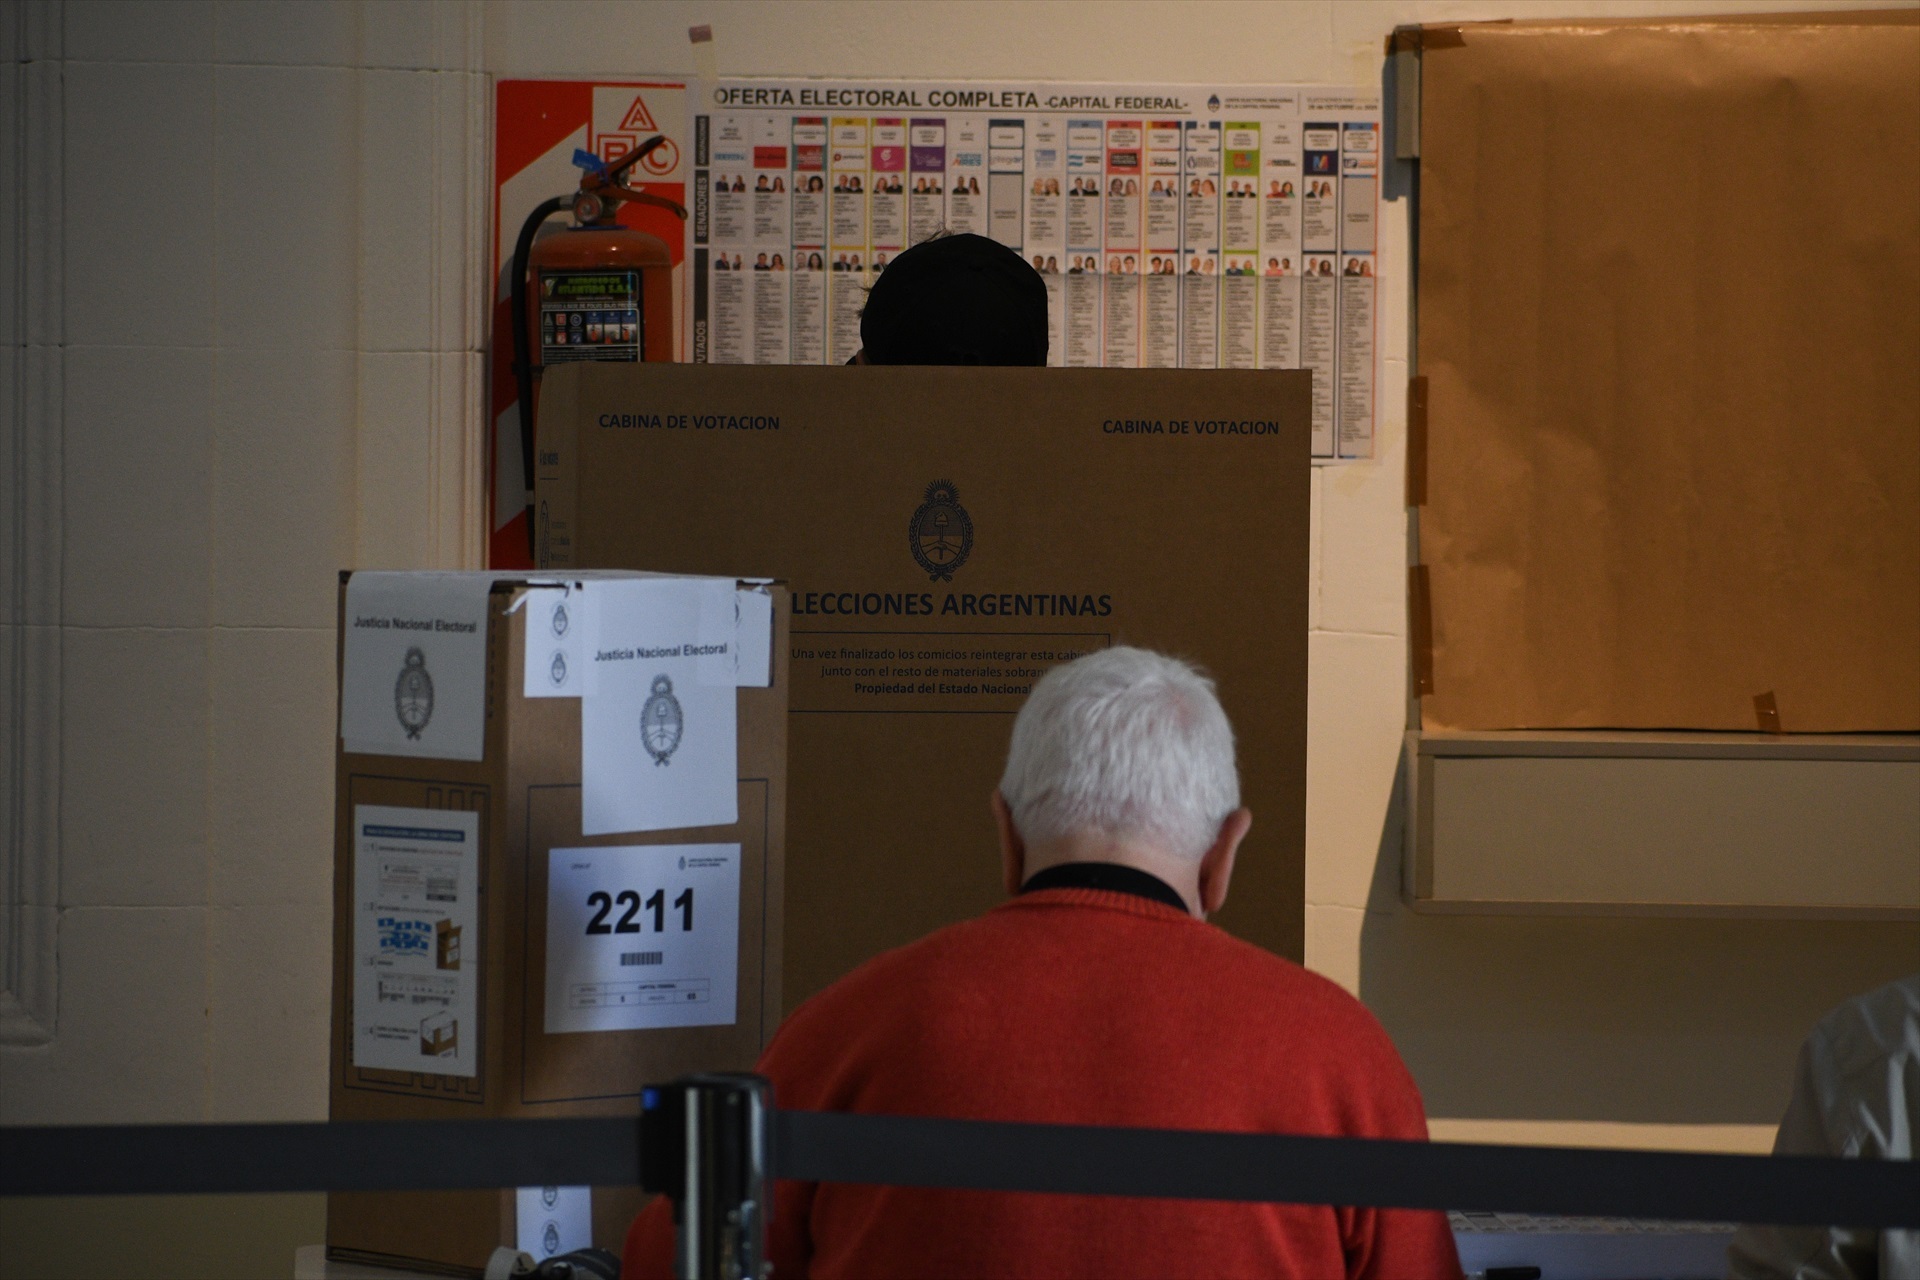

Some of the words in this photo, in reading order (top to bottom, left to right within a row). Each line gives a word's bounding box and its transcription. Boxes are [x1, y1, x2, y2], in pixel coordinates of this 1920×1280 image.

[715, 88, 794, 106] OFERTA
[799, 89, 922, 107] ELECTORAL
[928, 90, 1039, 108] COMPLETA
[630, 108, 647, 126] A
[648, 142, 668, 169] C
[696, 177, 708, 238] SENADORES
[695, 321, 707, 364] UTADOS
[599, 414, 662, 428] CABINA
[667, 415, 688, 429] DE
[692, 415, 780, 430] VOTACION
[1103, 420, 1164, 434] CABINA
[1169, 421, 1189, 435] DE
[1194, 421, 1279, 435] VOTACION
[791, 592, 934, 616] LECCIONES
[941, 593, 1113, 617] ARGENTINAS
[354, 616, 390, 629] Justicia
[392, 617, 433, 631] Nacional
[435, 618, 477, 633] Electoral
[595, 648, 635, 662] Justicia
[637, 645, 681, 659] Nacional
[683, 642, 728, 656] Electoral
[792, 648, 814, 660] Una
[818, 650, 837, 660] vez
[840, 648, 895, 660] finalizado
[898, 648, 915, 660] los
[917, 648, 967, 661] comicios
[970, 649, 1026, 662] reintegrar
[1030, 650, 1054, 661] esta
[820, 666, 852, 679] junto
[855, 668, 875, 677] con
[878, 666, 889, 677] el
[892, 667, 922, 677] resto
[924, 666, 939, 677] de
[942, 666, 1002, 678] materiales
[855, 683, 915, 696] Propiedad
[917, 683, 936, 694] del
[938, 683, 979, 695] Estado
[981, 683, 1032, 695] Nacional
[585, 887, 694, 935] 2211
